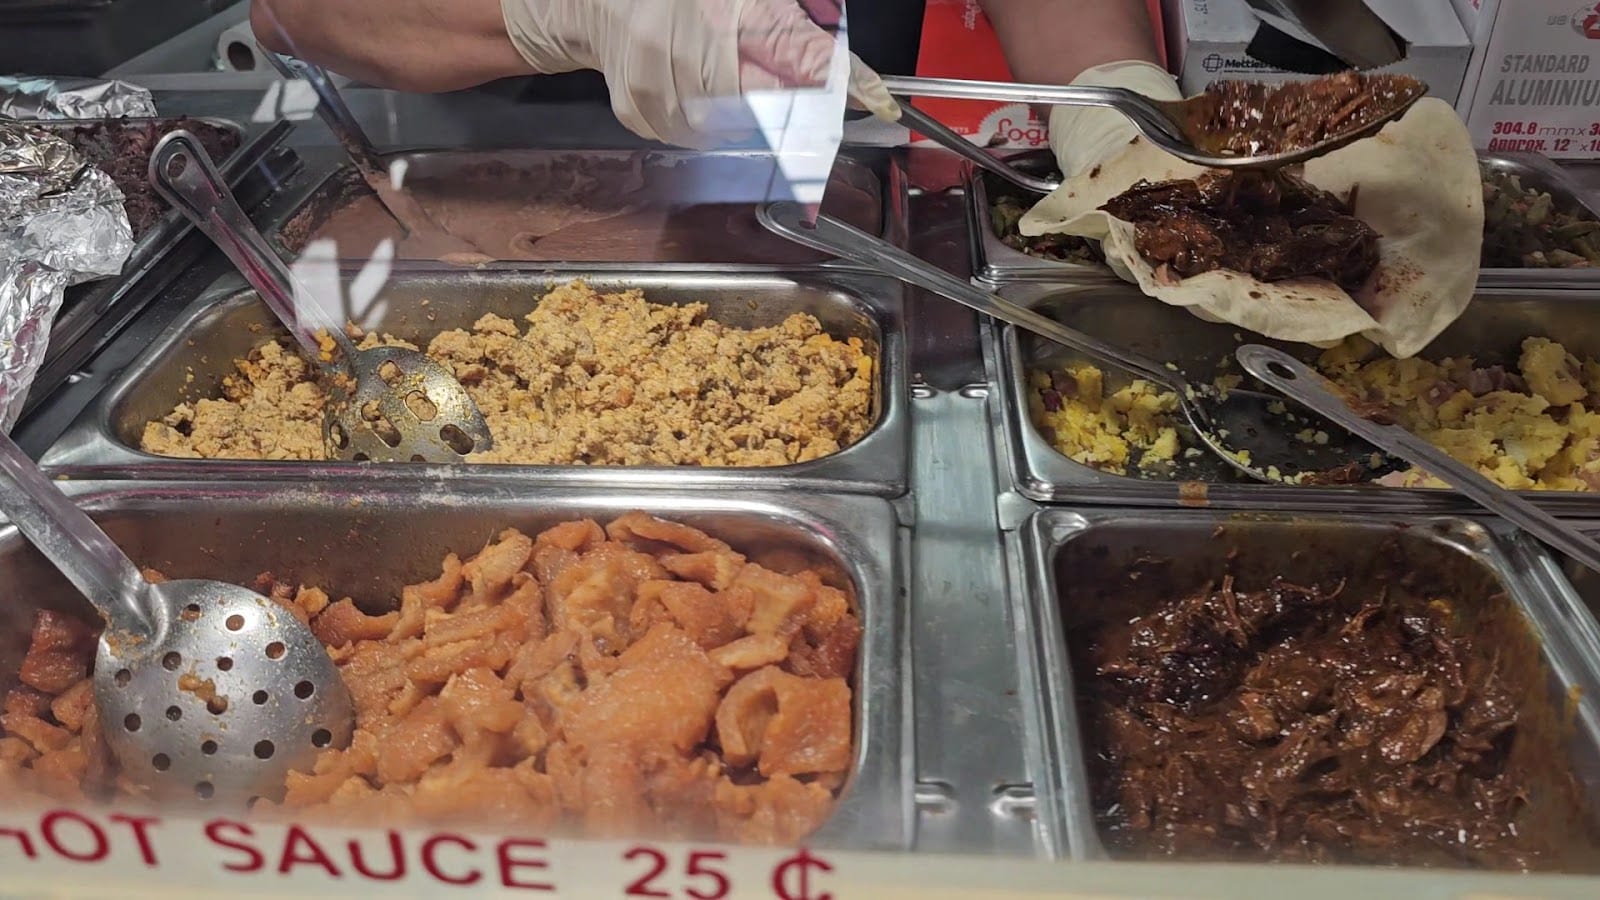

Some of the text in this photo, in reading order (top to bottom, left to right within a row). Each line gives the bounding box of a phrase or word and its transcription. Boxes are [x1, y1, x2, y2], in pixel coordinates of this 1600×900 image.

[1501, 54, 1590, 73] STANDARD
[1488, 79, 1600, 107] ALUMINIU
[1492, 121, 1538, 136] 304.8
[1588, 122, 1600, 136] 3
[204, 816, 556, 892] SAUCE
[622, 845, 731, 900] 25
